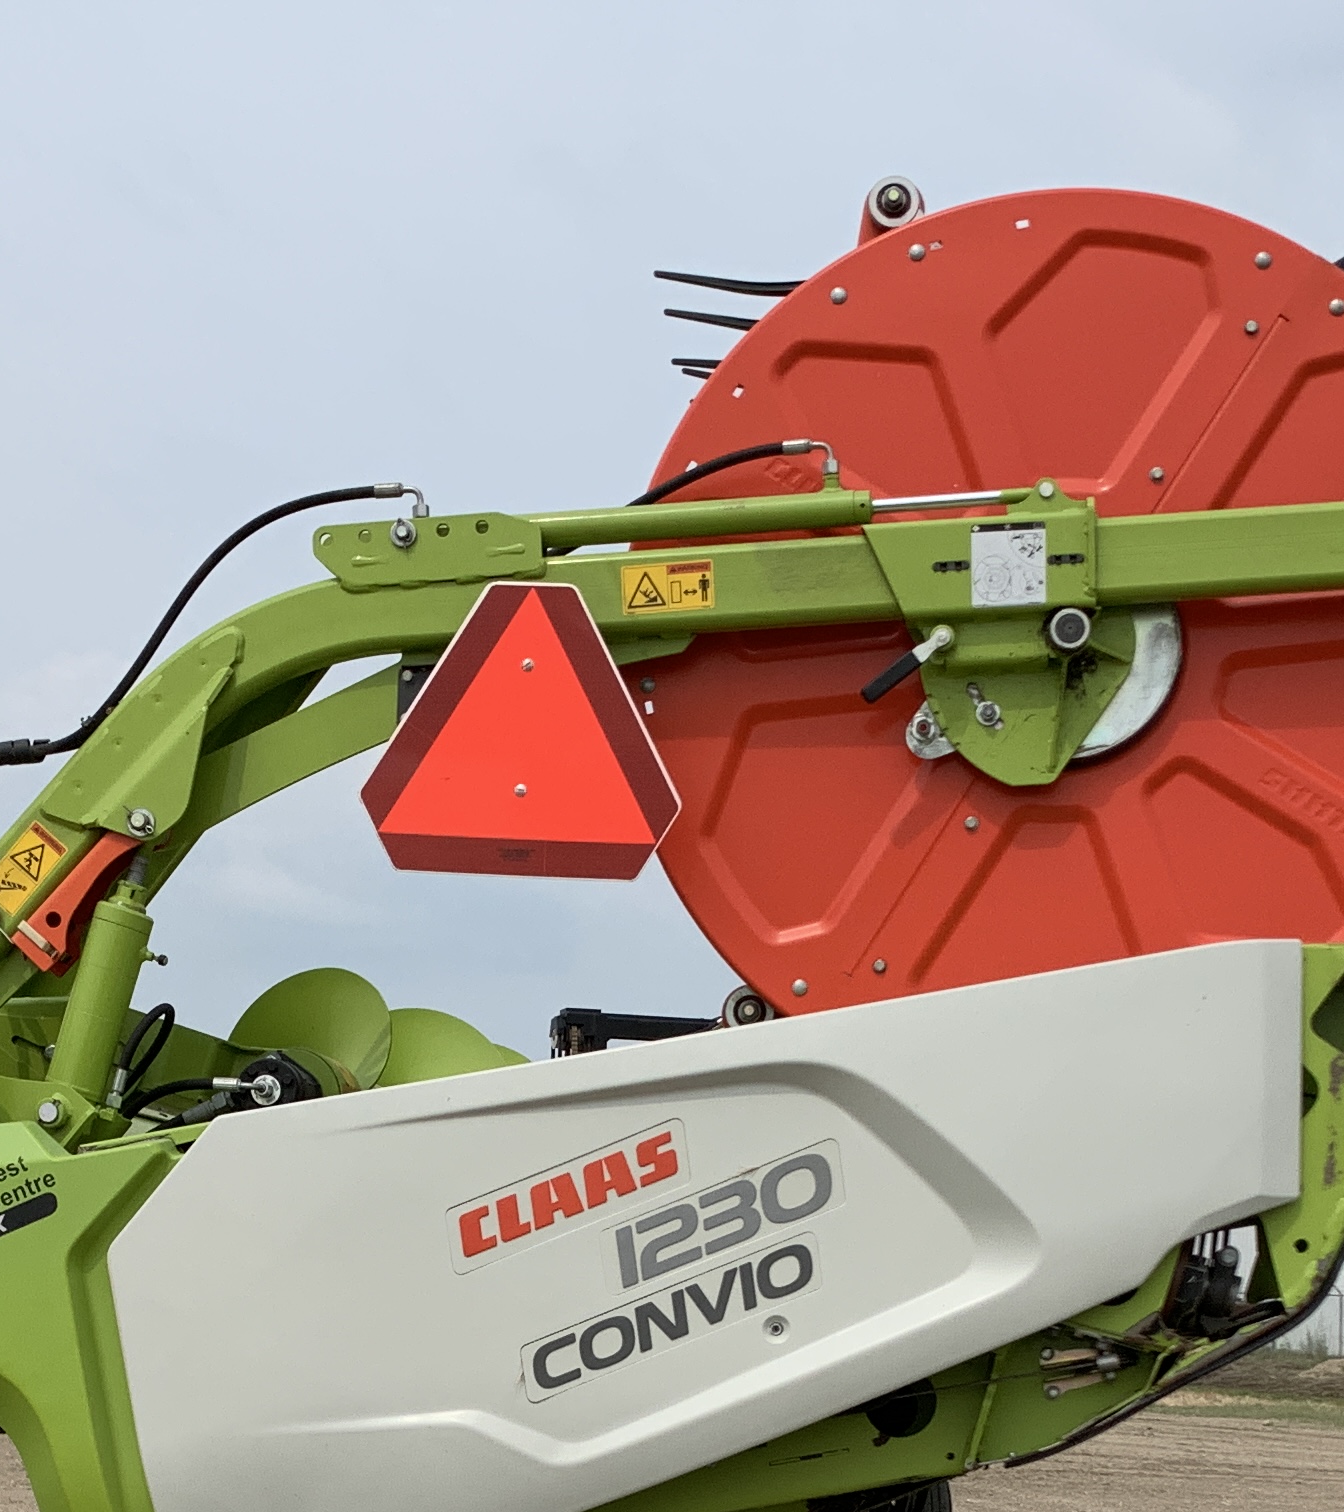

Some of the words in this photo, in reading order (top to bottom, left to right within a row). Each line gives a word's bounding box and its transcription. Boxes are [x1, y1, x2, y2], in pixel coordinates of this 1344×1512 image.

[458, 1130, 680, 1258] CLAAS
[615, 1152, 833, 1290] 1230
[532, 1243, 814, 1390] CONVIO
